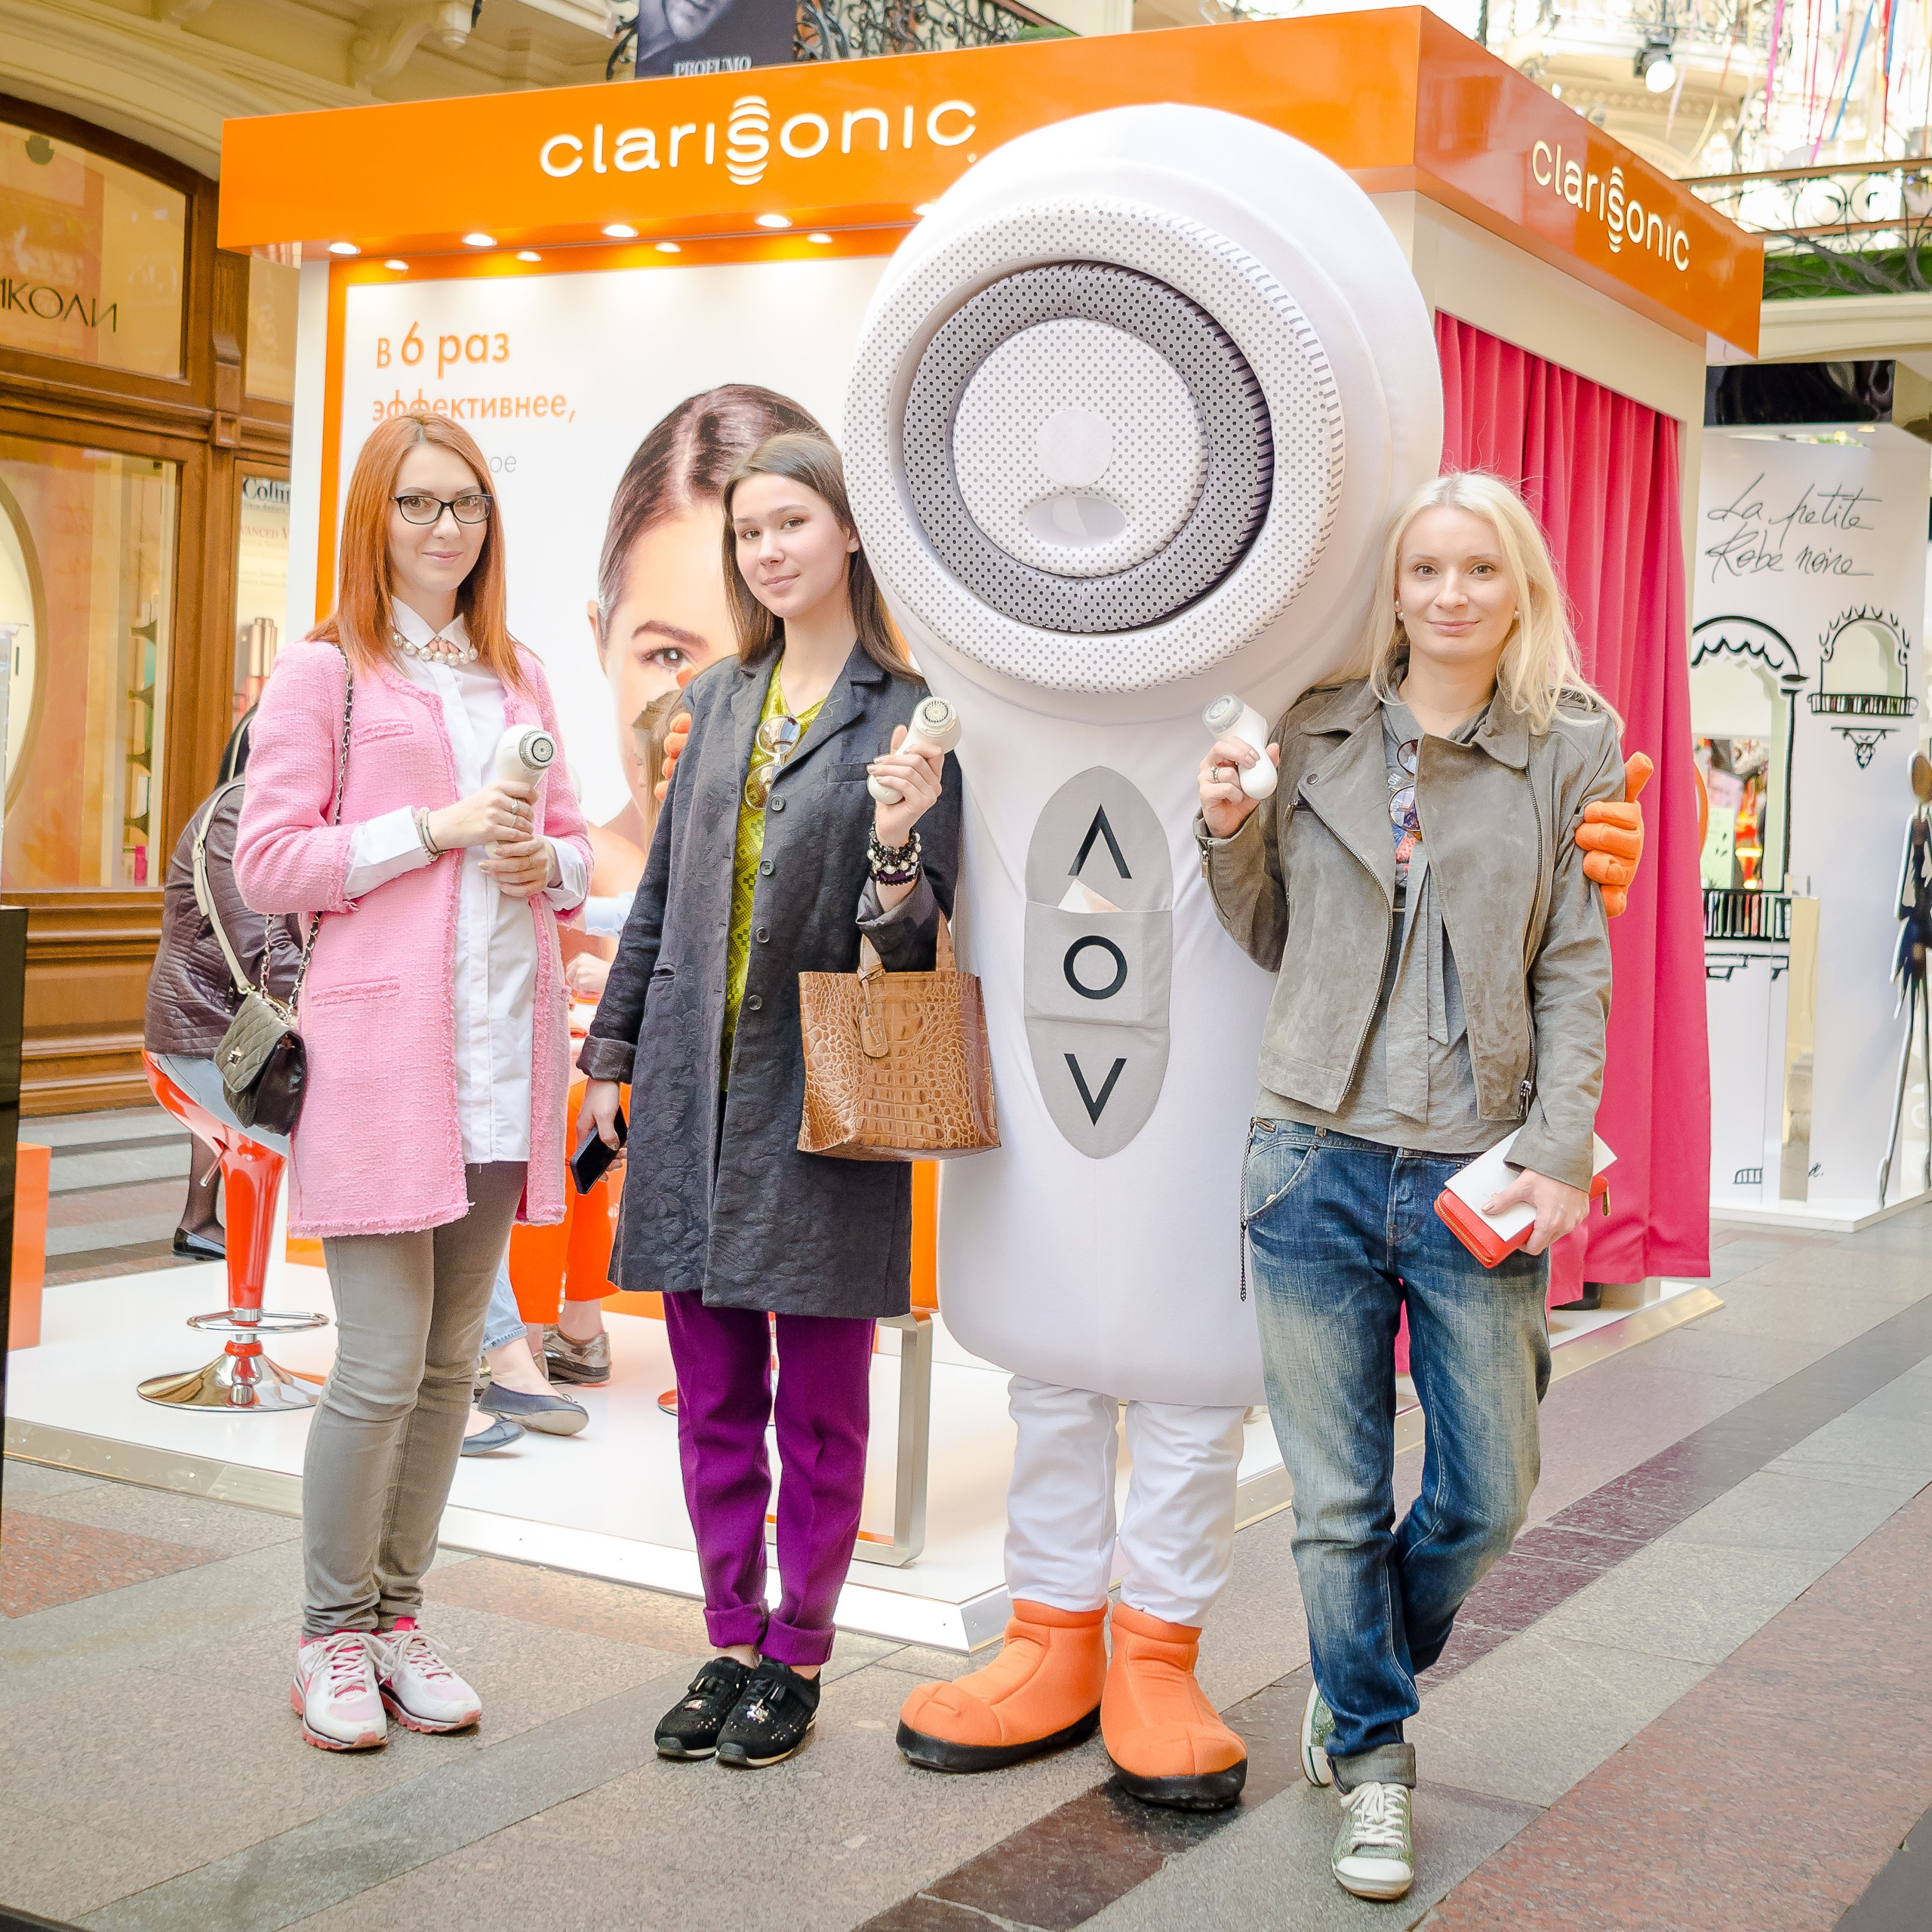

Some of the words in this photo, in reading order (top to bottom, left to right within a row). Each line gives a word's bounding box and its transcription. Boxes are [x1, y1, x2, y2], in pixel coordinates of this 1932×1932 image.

[540, 95, 977, 186] clarisonic
[1532, 139, 1690, 272] clarisonic
[0, 277, 118, 333] КОЛИ
[401, 321, 425, 367] 6
[437, 332, 511, 380] раз
[372, 388, 576, 423] эффективнее,
[1707, 472, 1765, 522] La
[1767, 482, 1883, 549] petite
[1704, 522, 1784, 583] Robe
[1795, 545, 1874, 576] noire
